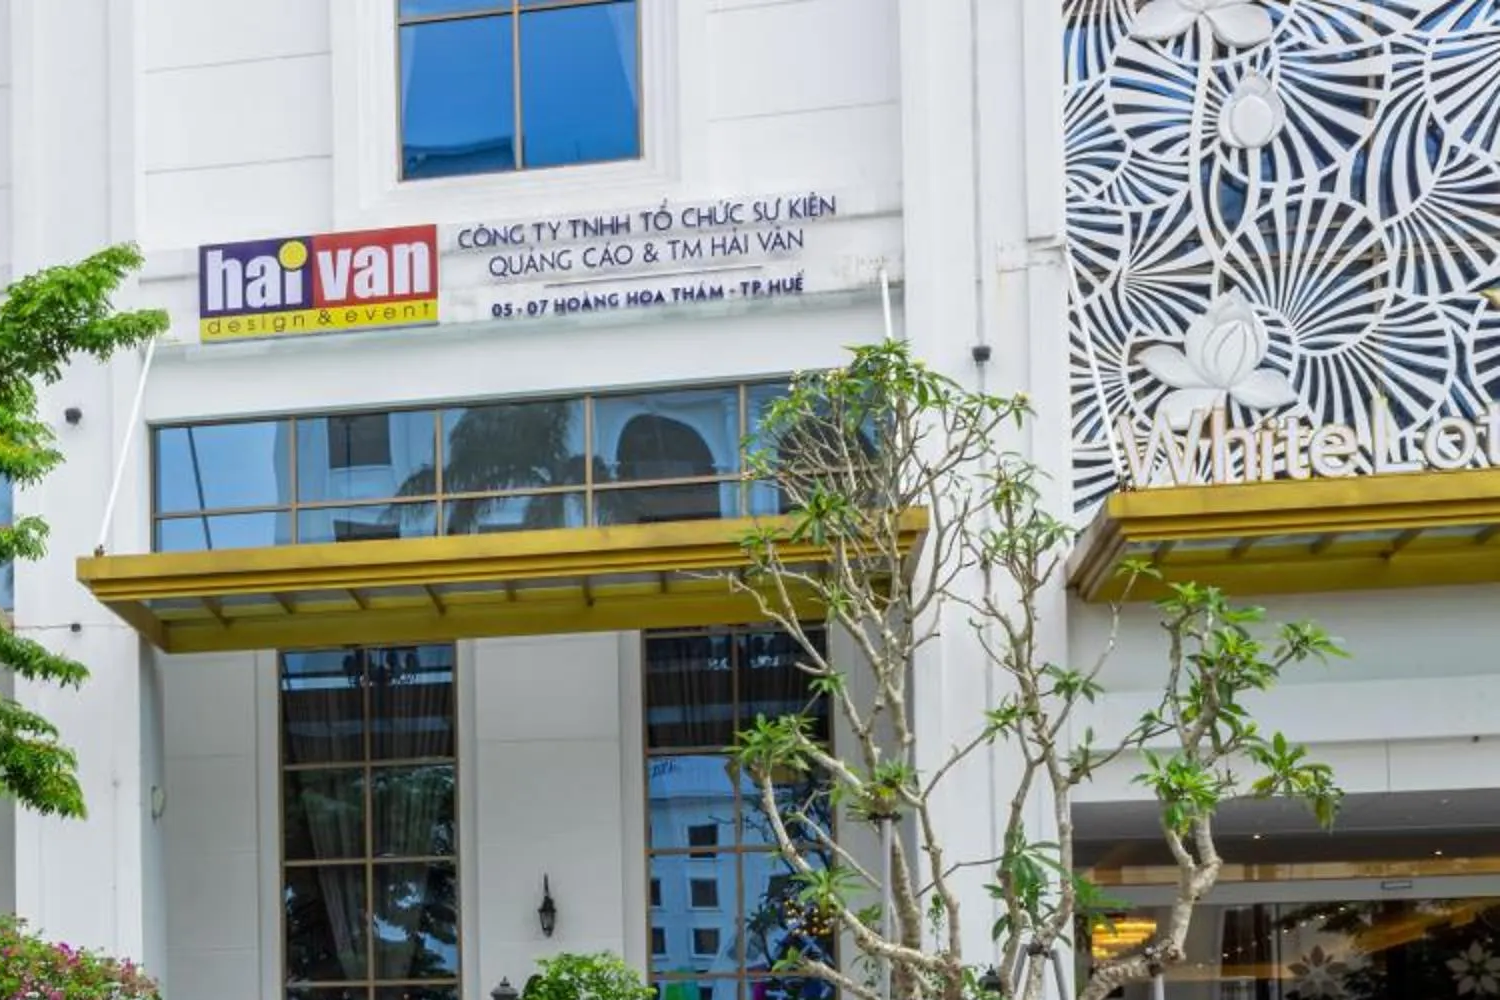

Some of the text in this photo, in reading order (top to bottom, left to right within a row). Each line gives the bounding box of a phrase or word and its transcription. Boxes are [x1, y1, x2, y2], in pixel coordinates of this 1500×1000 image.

[457, 191, 837, 250] CÔNG TY TNHH TỔ CHỨC SỰ KIỆN
[205, 240, 433, 312] hai van
[488, 225, 805, 278] QUẢNG CÁO & TM HẢI VÂN
[206, 302, 432, 336] design & event
[491, 302, 513, 318] 05
[526, 299, 550, 316] 07
[626, 290, 666, 306] HOA
[1117, 405, 1357, 487] White
